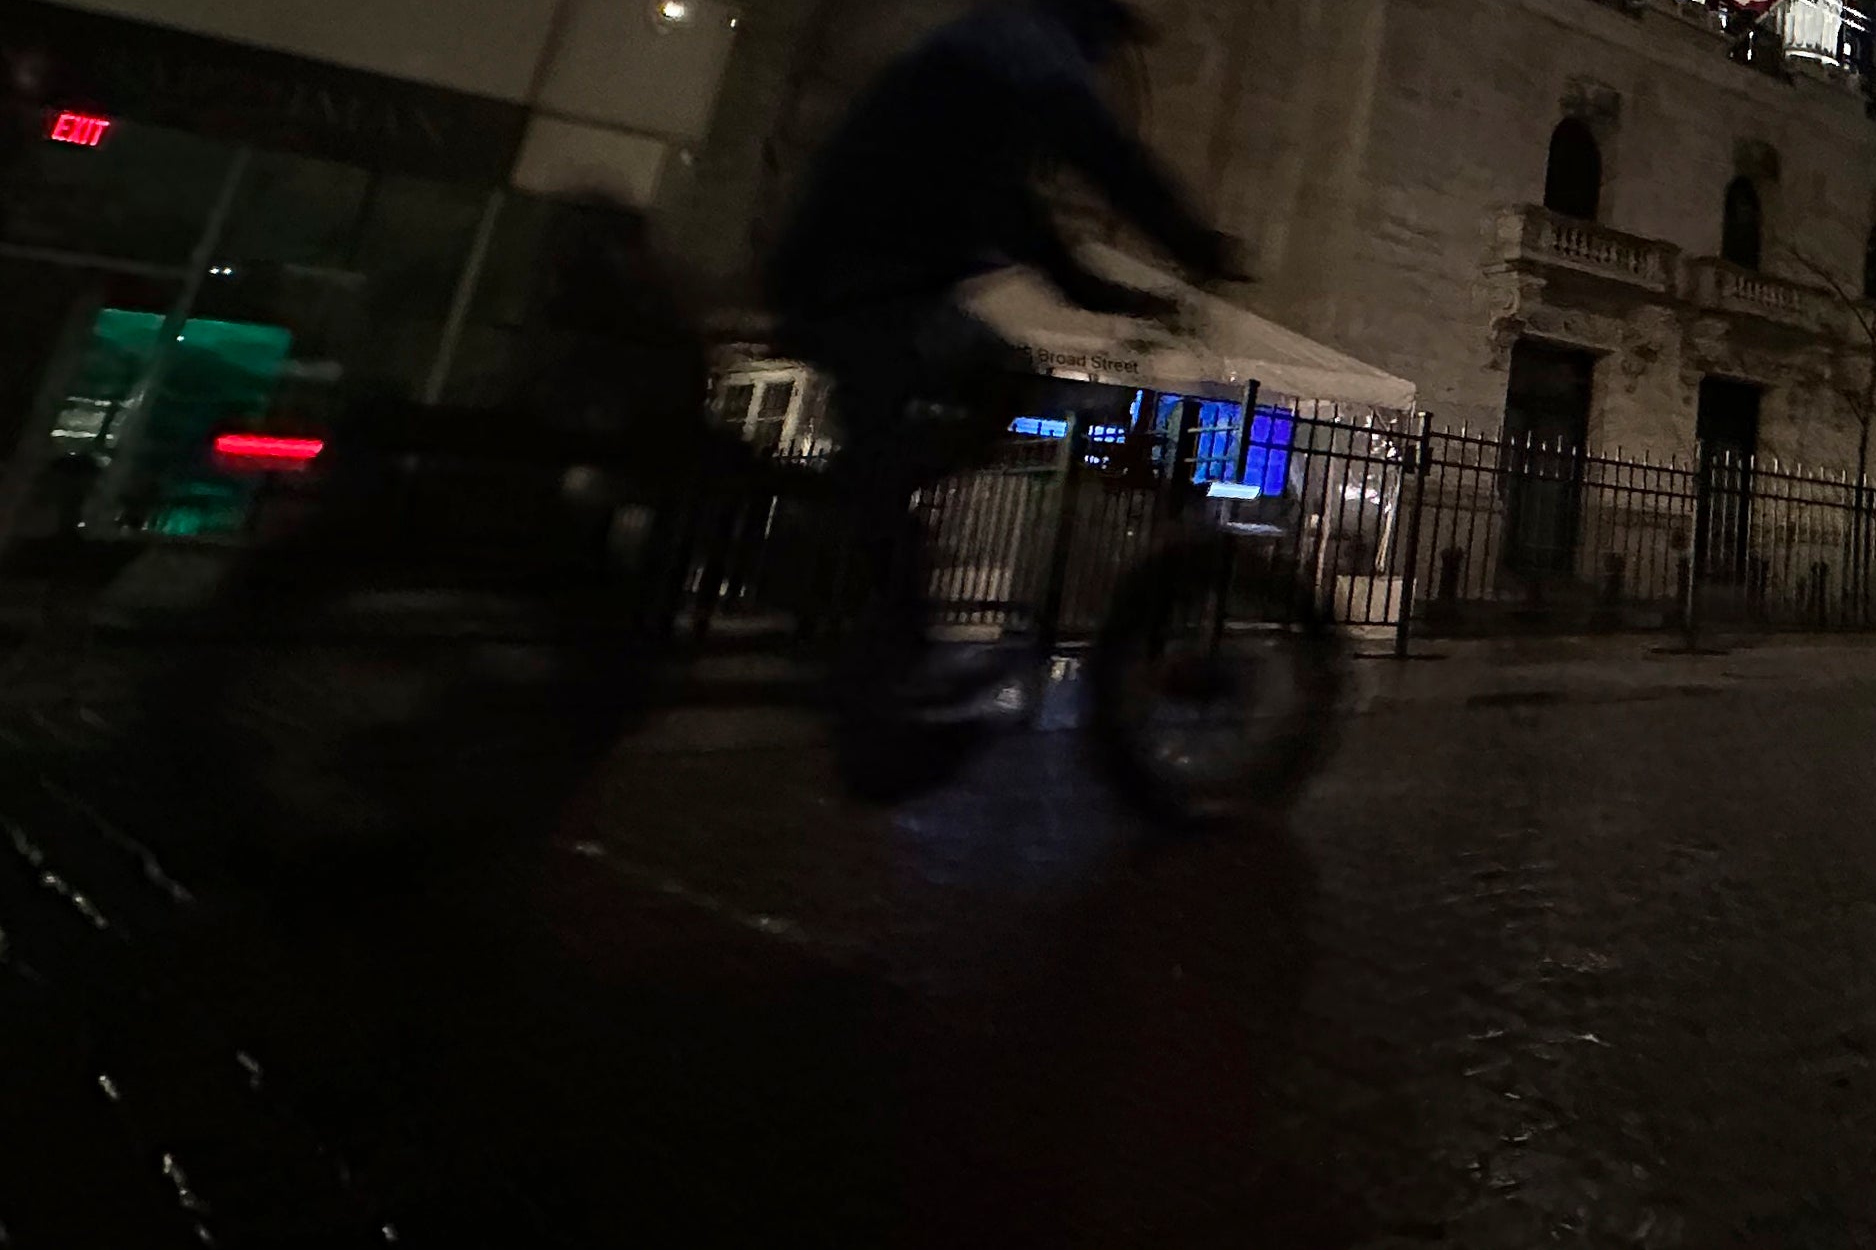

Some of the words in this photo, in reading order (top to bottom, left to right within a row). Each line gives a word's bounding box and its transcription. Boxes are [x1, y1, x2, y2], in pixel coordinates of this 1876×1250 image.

[51, 113, 111, 147] EXIT
[1038, 347, 1086, 368] Broad
[1091, 354, 1140, 375] Street
